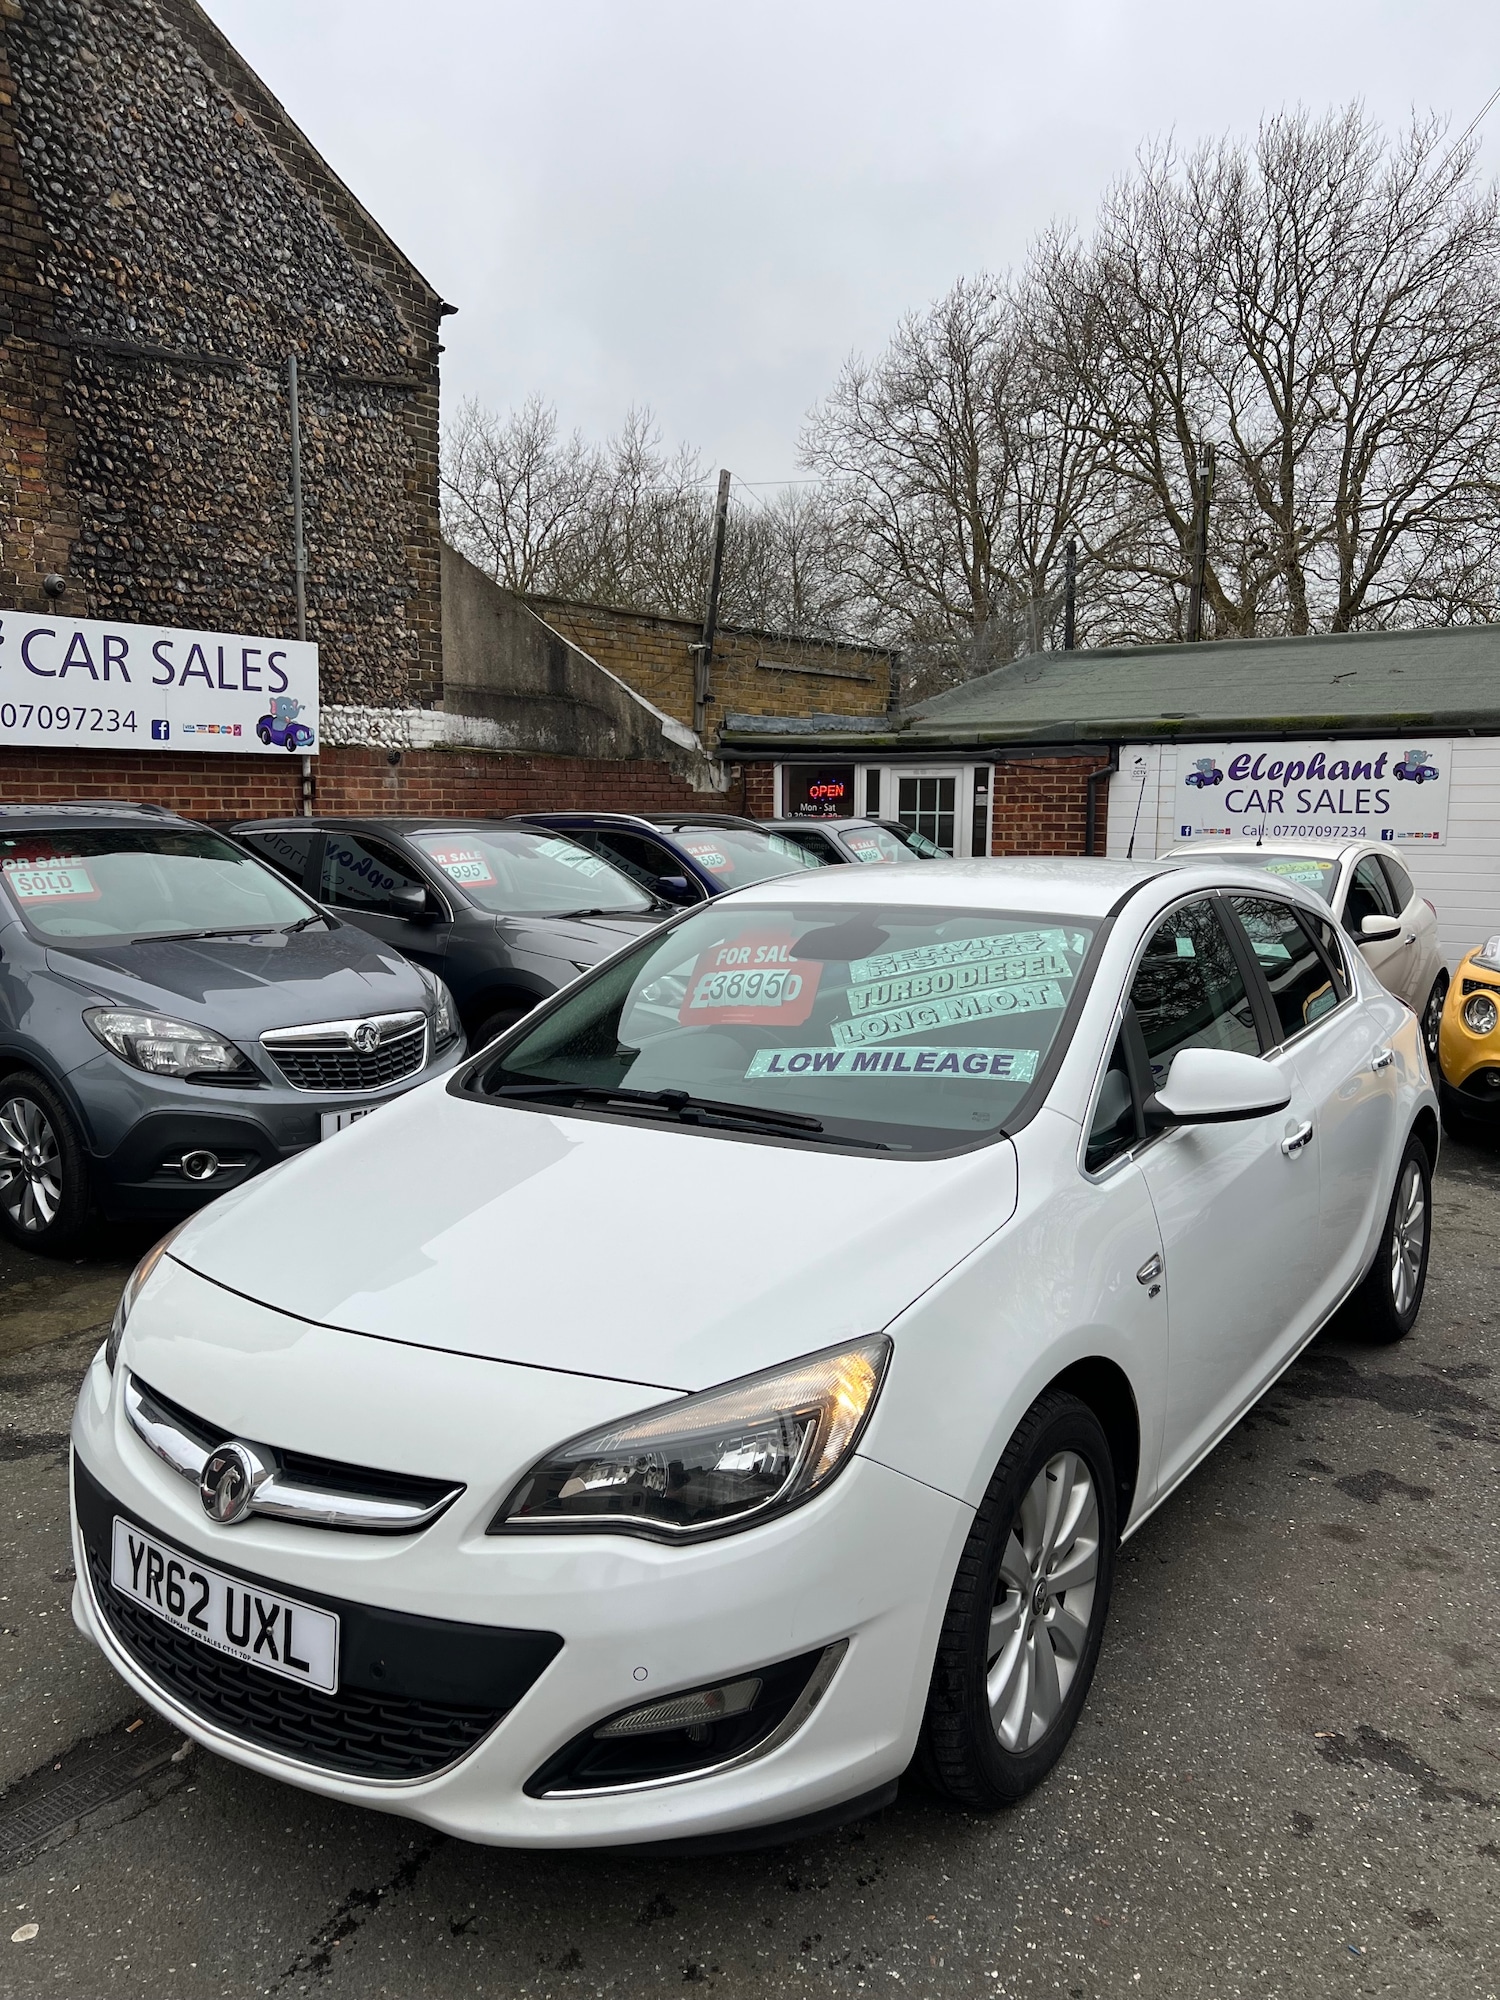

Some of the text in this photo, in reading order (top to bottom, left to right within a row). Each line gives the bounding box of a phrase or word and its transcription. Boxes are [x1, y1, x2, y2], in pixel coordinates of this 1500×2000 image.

[21, 628, 132, 683] CAR
[152, 640, 289, 693] SALES
[1, 703, 138, 733] 07097234
[1228, 751, 1389, 787] Elephant
[810, 785, 844, 797] OPEN
[1225, 789, 1391, 814] CAR SALES
[800, 803, 817, 811] Mon
[824, 803, 836, 811] Sat
[1273, 825, 1367, 837] 07707097234
[701, 845, 717, 853] SALE
[858, 840, 876, 849] SALE
[1, 855, 82, 870] OR SALE
[431, 851, 482, 863] OR SALE
[701, 854, 723, 866] 595
[18, 875, 72, 891] SOLD
[716, 946, 752, 966] FOR
[866, 932, 1044, 966] SERVICE
[867, 941, 1047, 977] HISTORY
[854, 955, 1064, 1010] TURBO DIESEL
[839, 984, 1052, 1046] LONG M.O.T
[767, 1052, 1015, 1076] LOW MILEAGE
[128, 1534, 310, 1673] YR62 UXL
[165, 1614, 190, 1633] ELEPHANT
[190, 1629, 202, 1640] CAR
[203, 1635, 221, 1648] SALES
[222, 1644, 238, 1655] CT11
